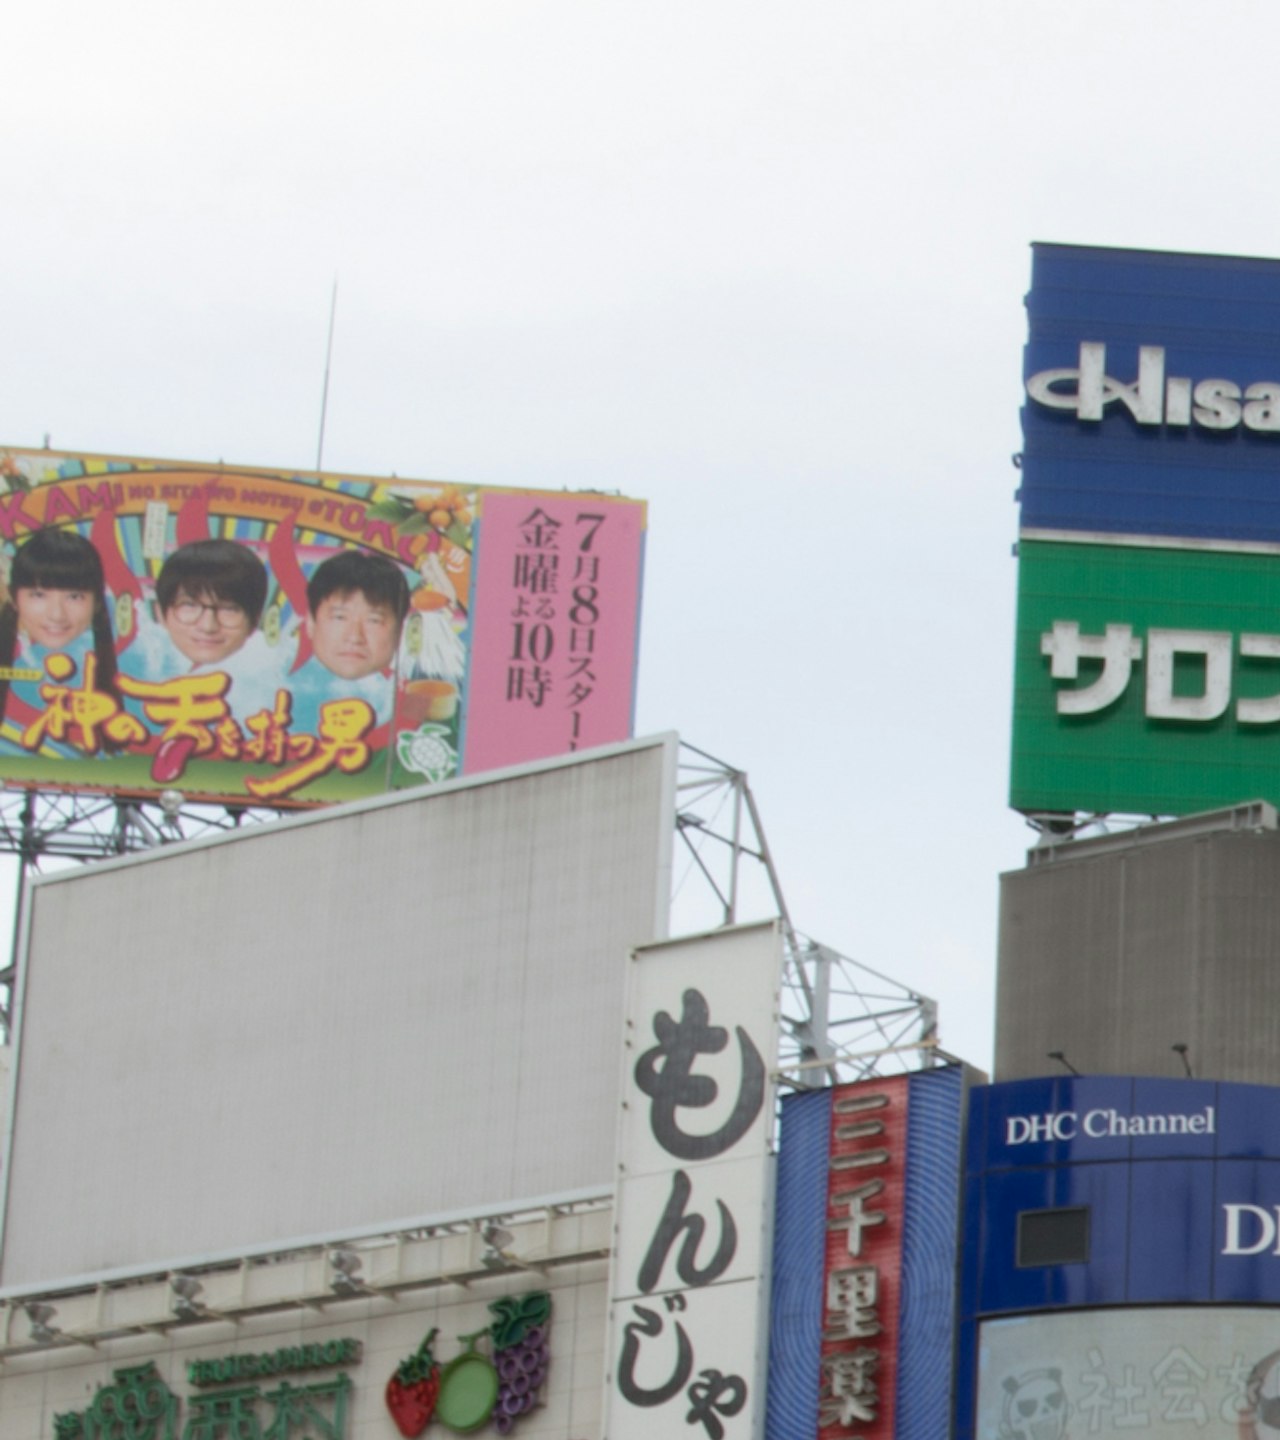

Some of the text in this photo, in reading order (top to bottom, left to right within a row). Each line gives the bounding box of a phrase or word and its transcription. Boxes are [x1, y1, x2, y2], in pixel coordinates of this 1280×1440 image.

[0, 480, 124, 541] KAMI
[505, 506, 562, 709] 金曜よる10時
[1006, 1107, 1217, 1146] DHC Channel
